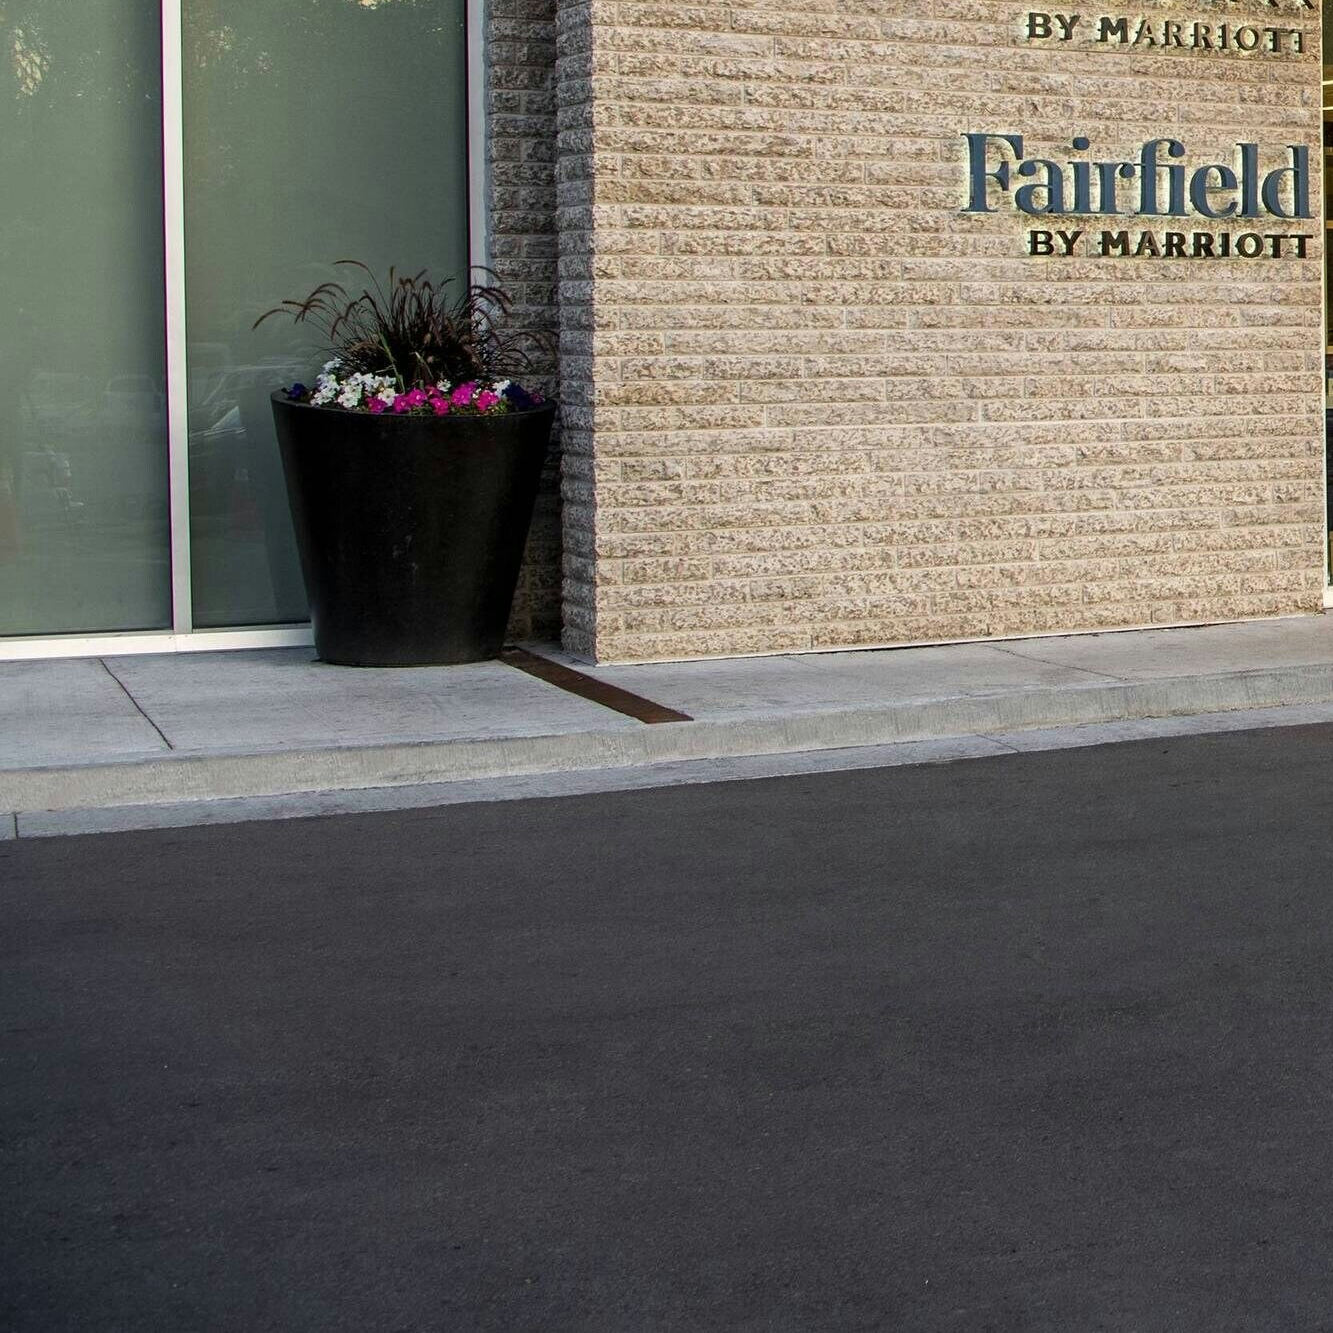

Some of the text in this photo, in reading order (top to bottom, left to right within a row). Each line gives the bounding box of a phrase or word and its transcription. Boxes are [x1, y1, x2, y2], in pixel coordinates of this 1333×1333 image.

[1026, 12, 1313, 54] BY MARRIOTT
[960, 133, 1315, 219] Fairfield
[1028, 230, 1314, 259] BY MARRIOTT
